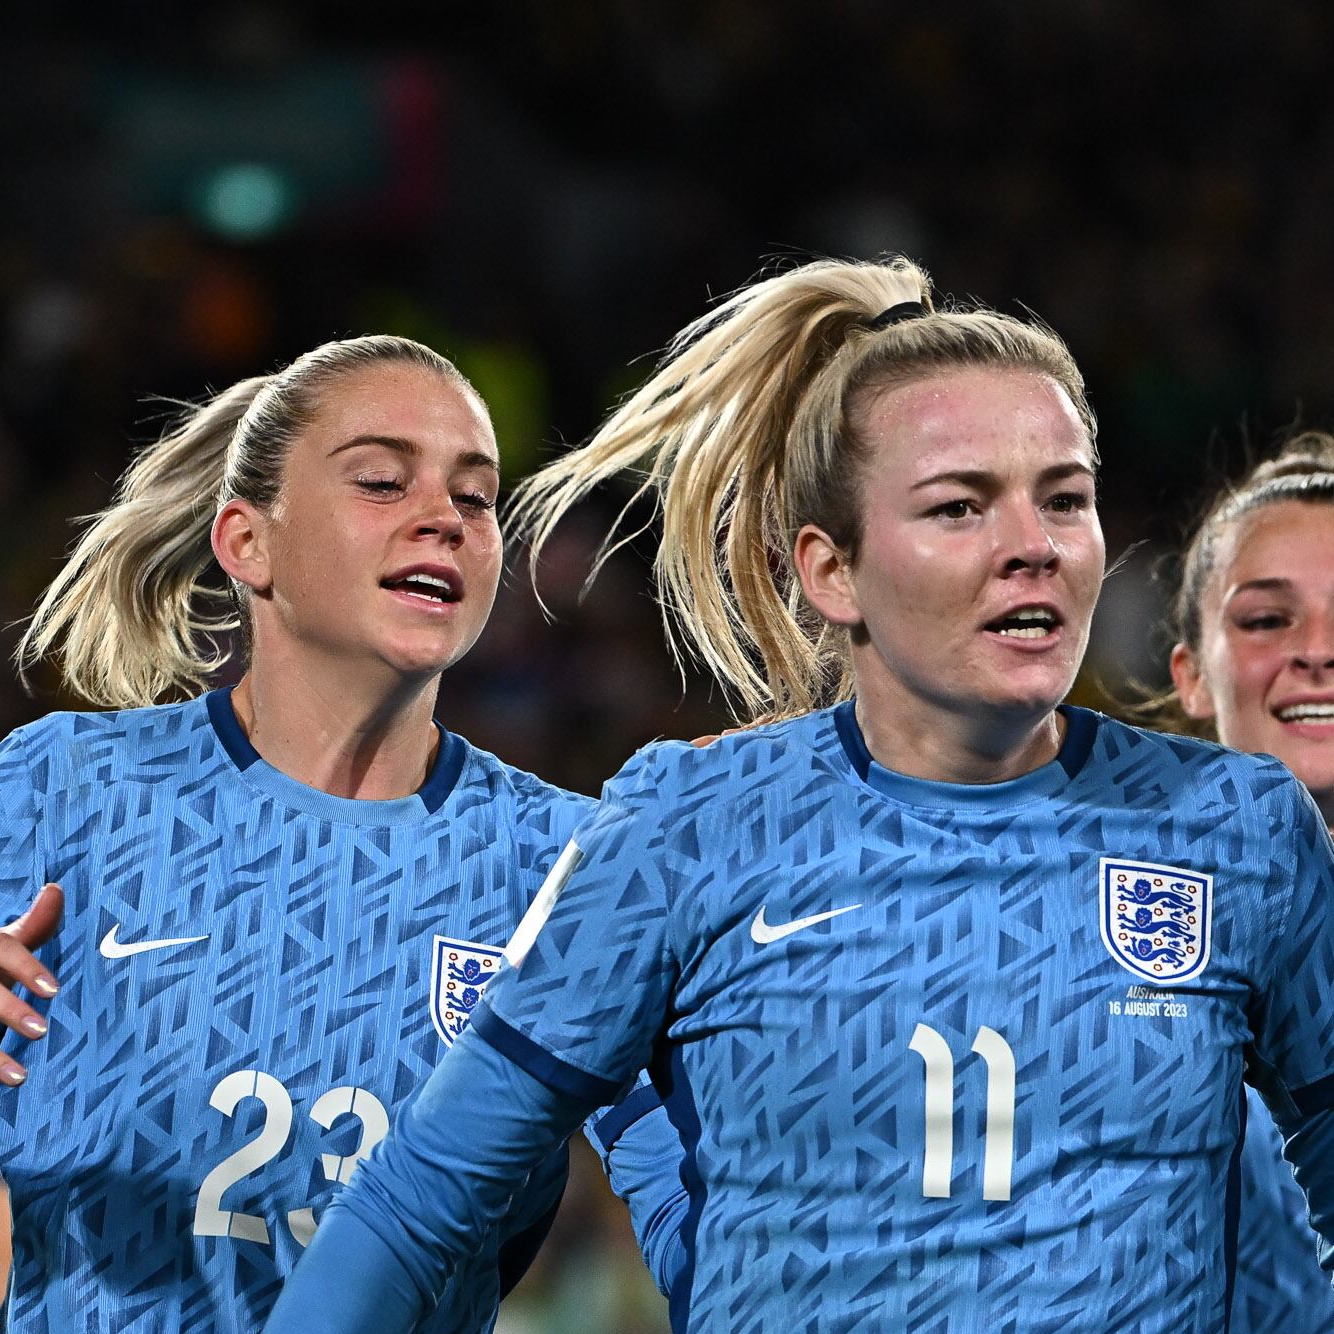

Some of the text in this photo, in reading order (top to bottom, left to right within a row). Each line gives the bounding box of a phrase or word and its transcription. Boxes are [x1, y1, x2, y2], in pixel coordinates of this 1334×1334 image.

[1109, 1001, 1187, 1018] 16 AUGUST 2023
[908, 1022, 1016, 1201] 11
